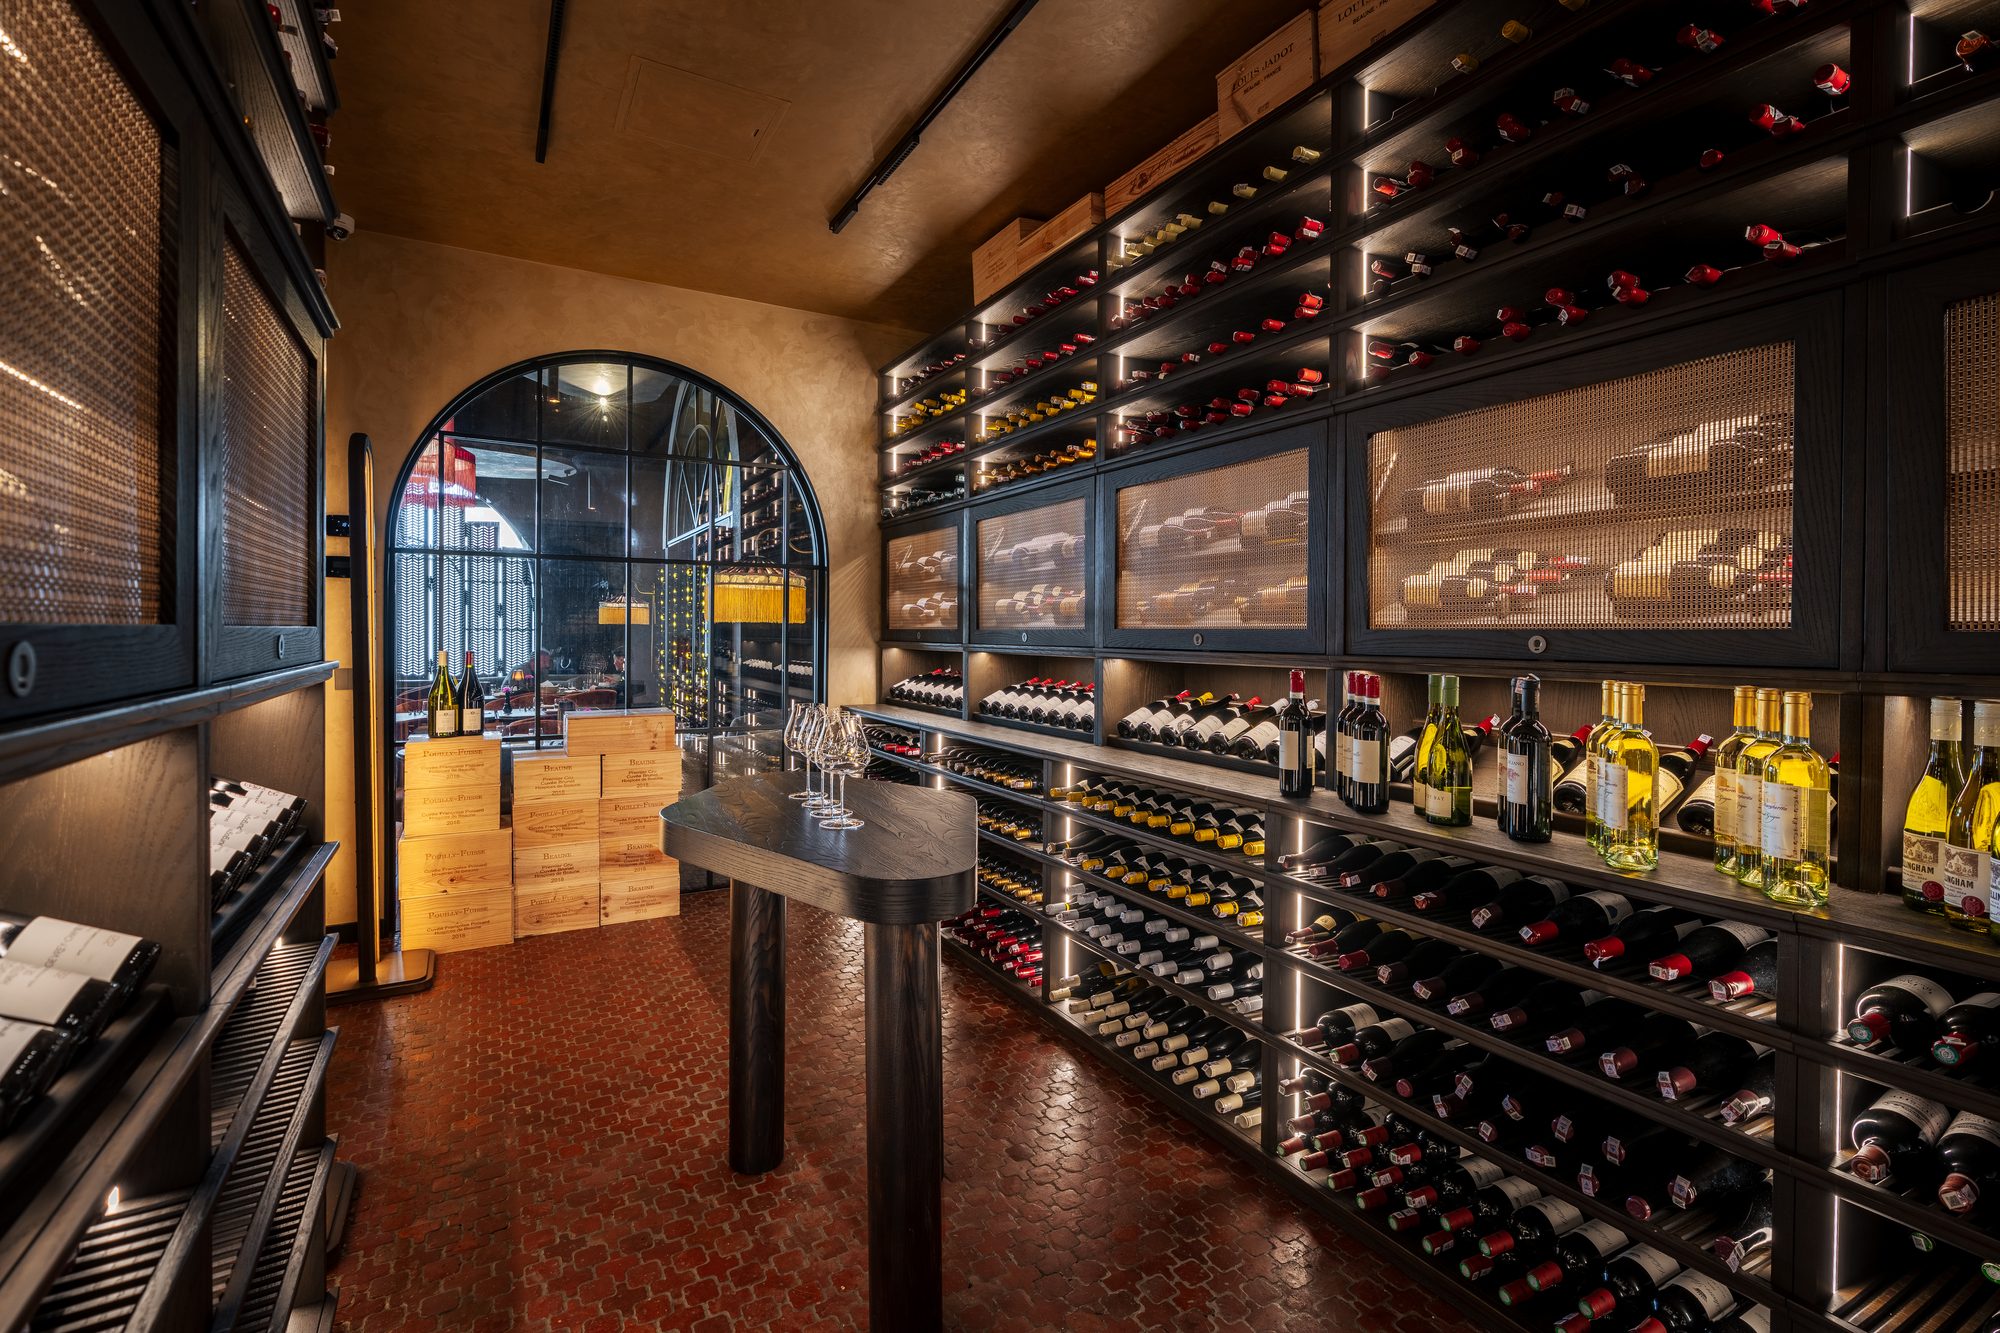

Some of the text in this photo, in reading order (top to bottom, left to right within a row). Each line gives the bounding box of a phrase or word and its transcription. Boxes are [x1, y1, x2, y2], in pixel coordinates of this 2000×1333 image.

[1336, 0, 1371, 23] LOUI
[1231, 42, 1295, 93] LOUIS JADOT
